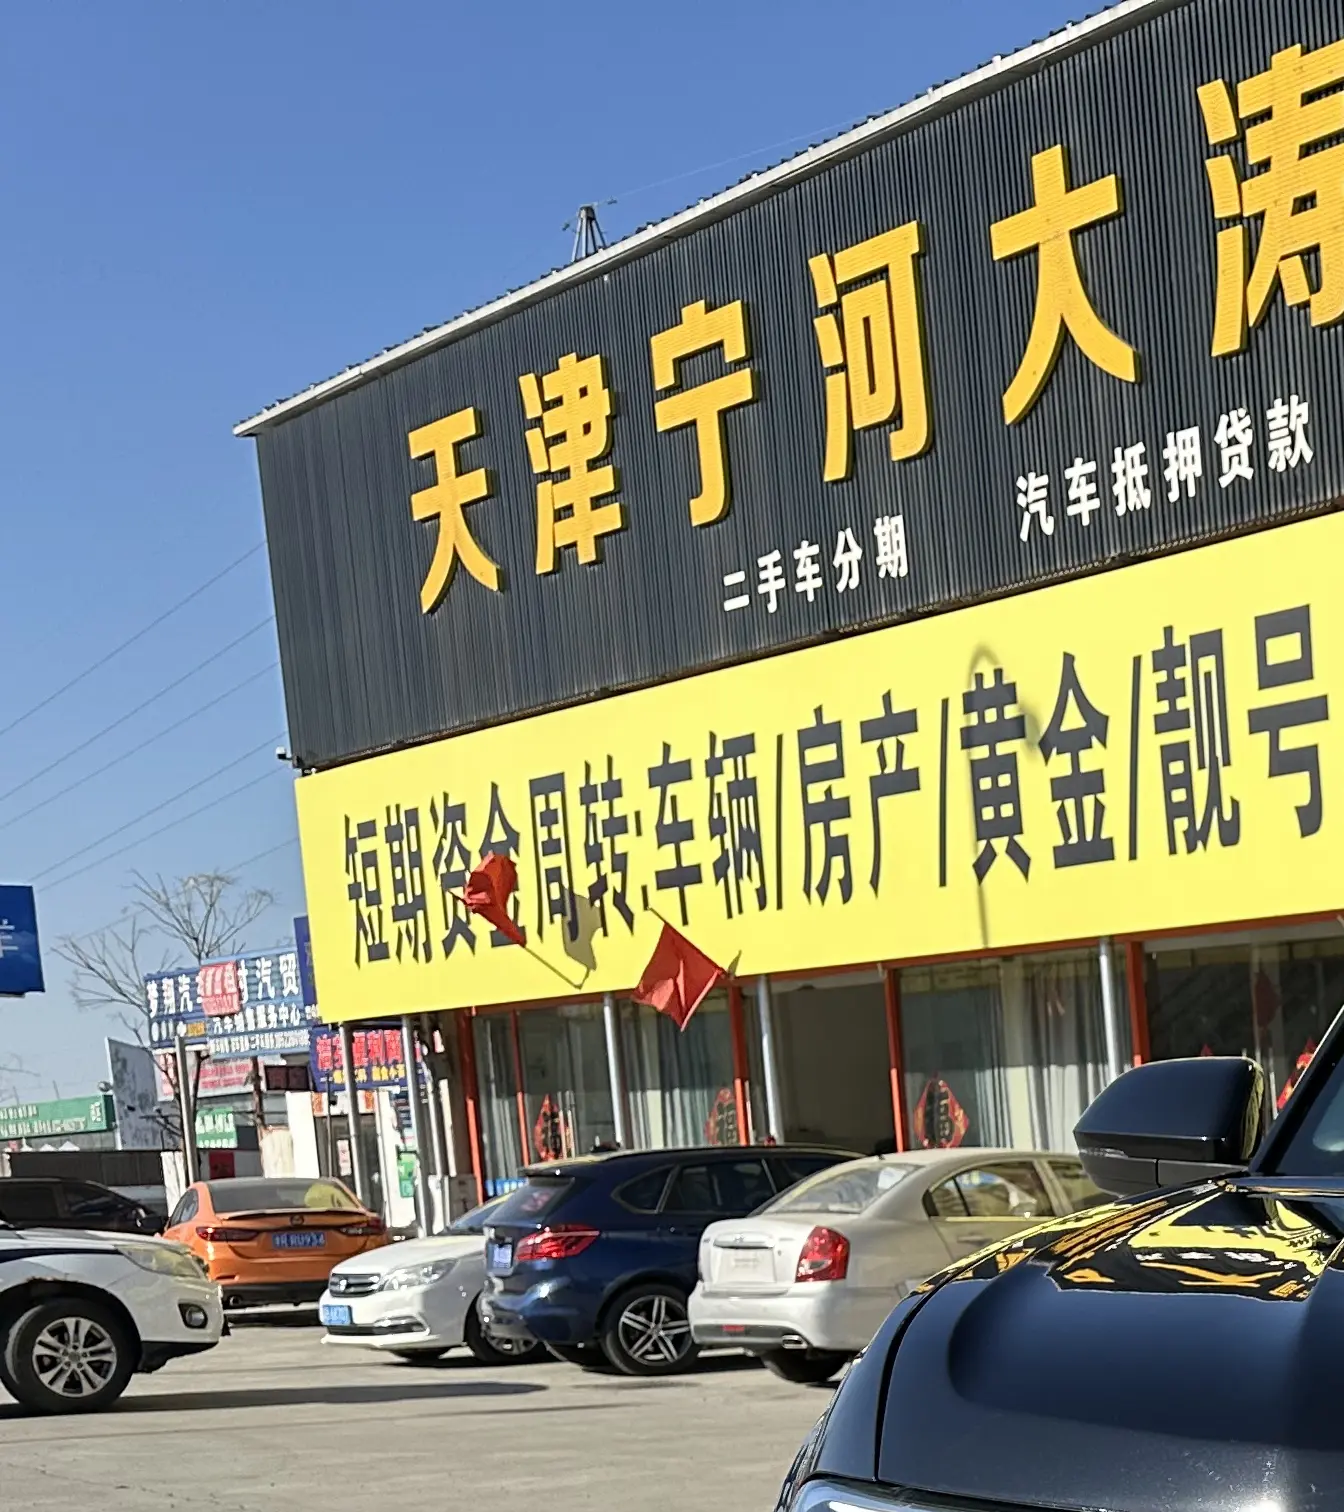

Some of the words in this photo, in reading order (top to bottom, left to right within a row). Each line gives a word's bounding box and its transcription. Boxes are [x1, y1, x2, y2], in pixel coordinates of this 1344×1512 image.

[723, 515, 908, 613] 二手车分期
[1015, 394, 1316, 542] 汽车抵押贷款
